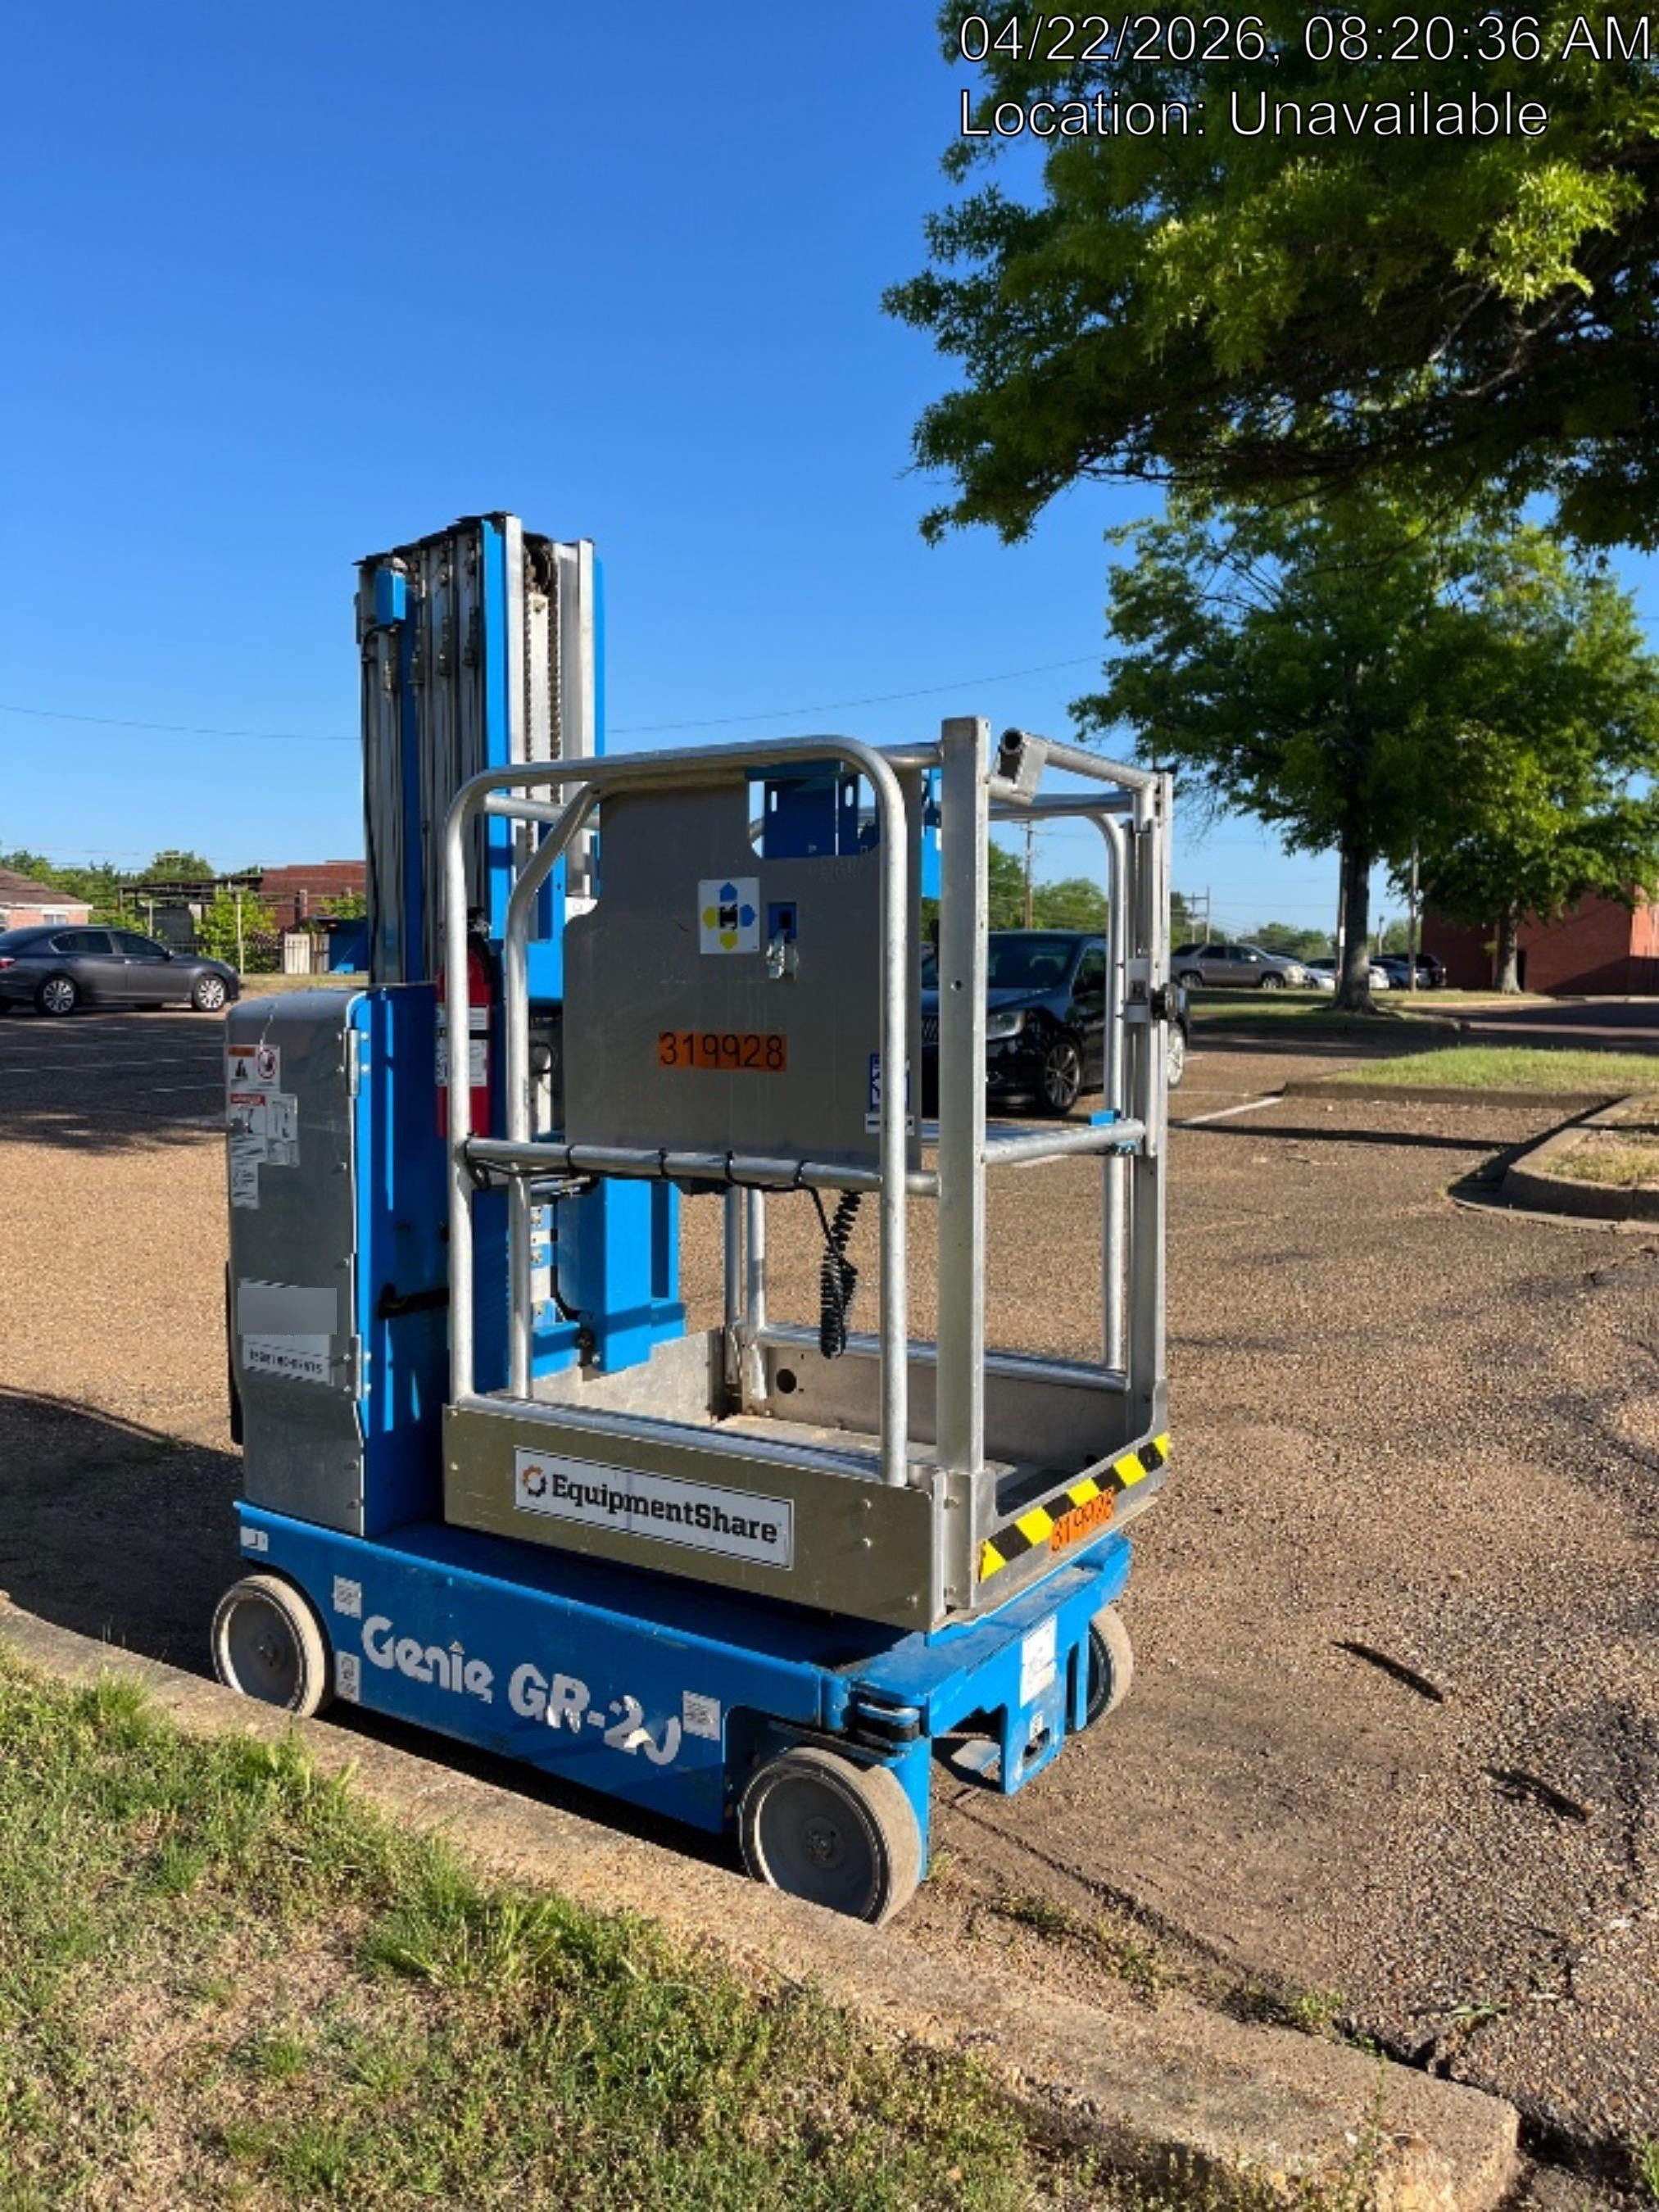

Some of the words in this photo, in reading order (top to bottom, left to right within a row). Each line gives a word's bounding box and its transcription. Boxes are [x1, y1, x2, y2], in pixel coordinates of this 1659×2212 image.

[660, 1031, 784, 1070] 319928
[551, 1473, 778, 1545] EquipmentShare
[361, 1615, 495, 1704] Genie
